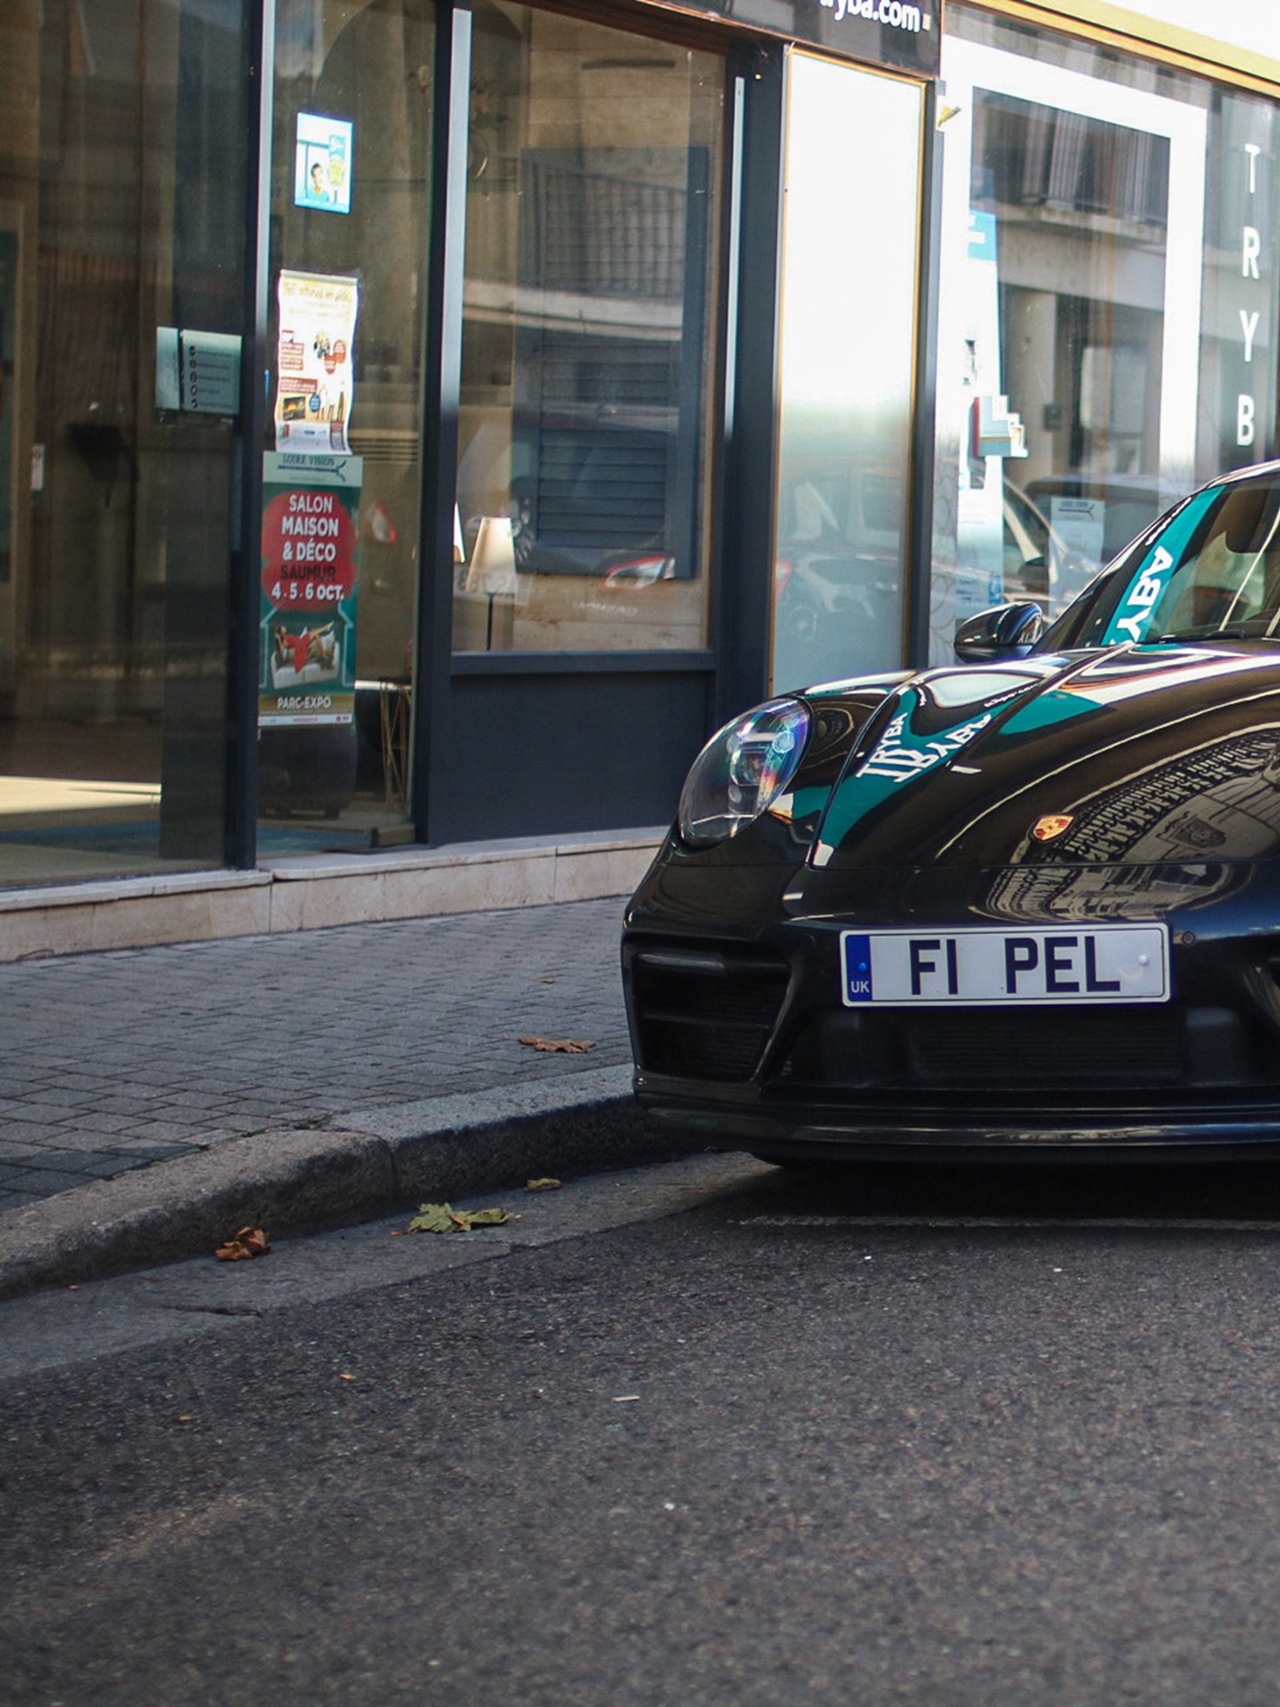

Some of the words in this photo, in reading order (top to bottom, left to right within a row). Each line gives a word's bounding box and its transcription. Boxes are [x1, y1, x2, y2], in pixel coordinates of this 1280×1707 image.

[289, 494, 333, 514] SALON
[281, 516, 339, 537] MAISON
[282, 541, 293, 561] &
[296, 538, 336, 562] DÉCO
[280, 565, 336, 581] SAUMUR
[317, 585, 345, 600] OCT.
[277, 695, 332, 710] PARC-EXPO
[1004, 935, 1121, 995] PEL
[851, 980, 870, 994] UK
